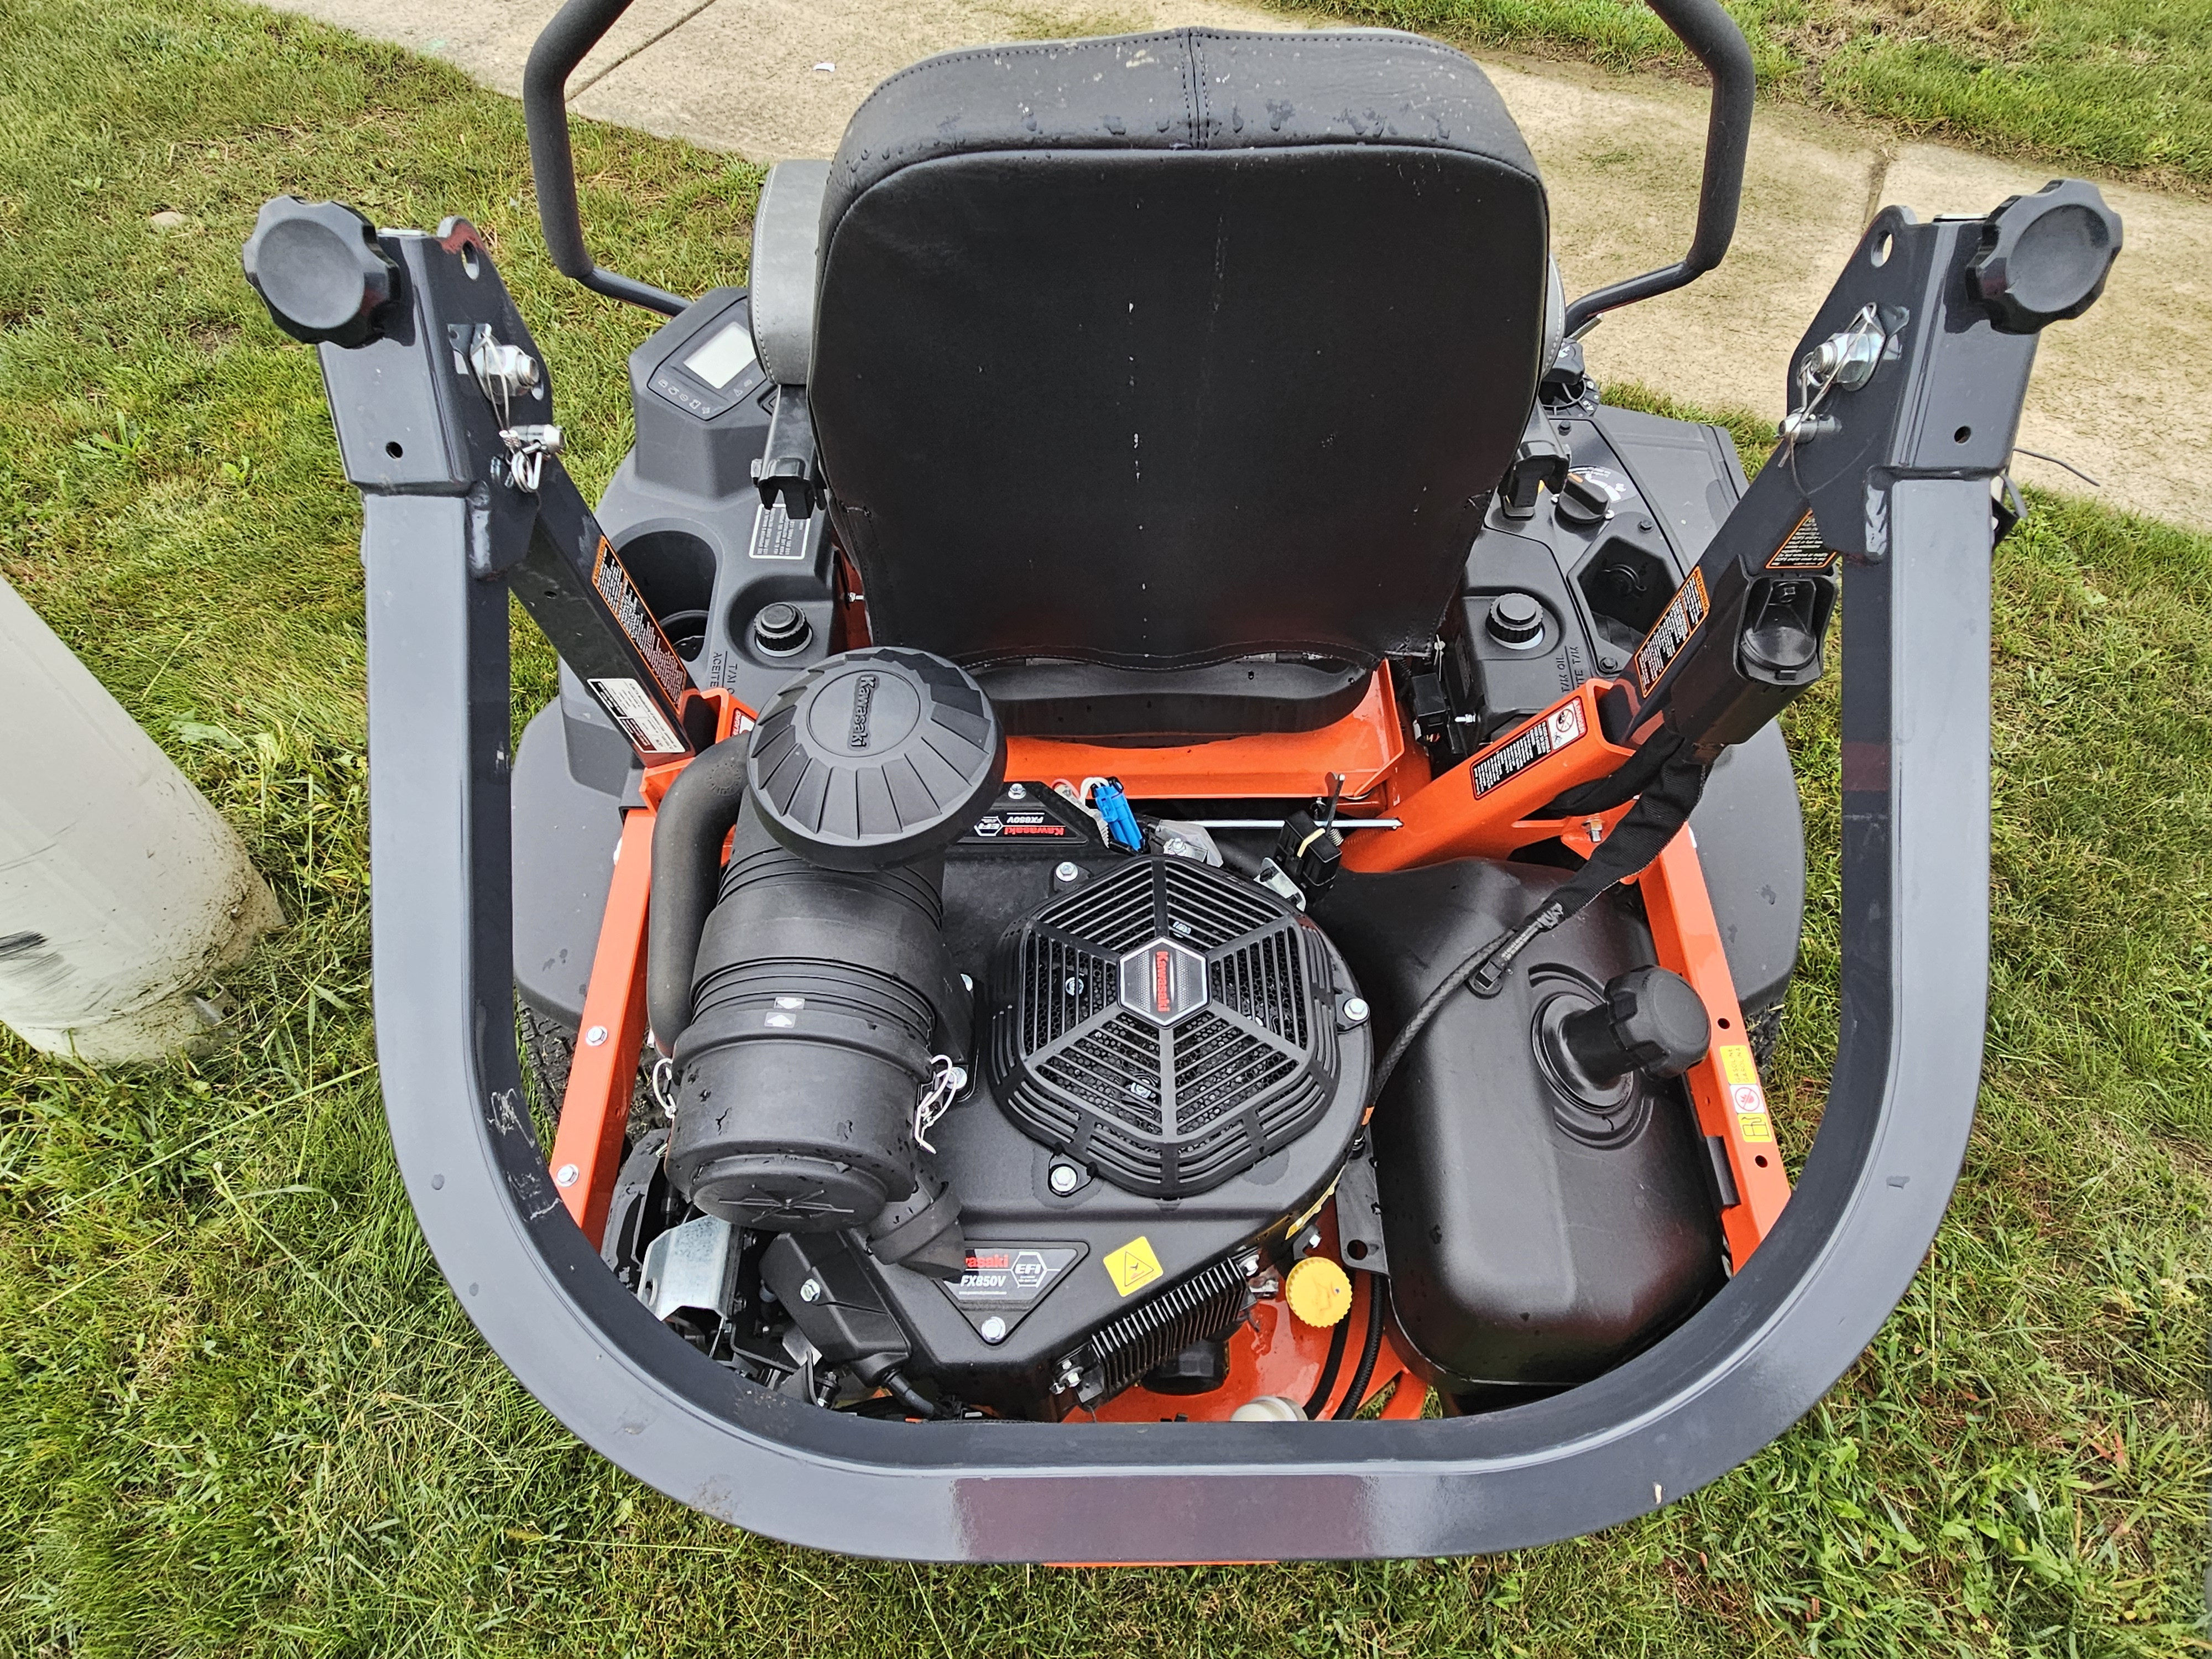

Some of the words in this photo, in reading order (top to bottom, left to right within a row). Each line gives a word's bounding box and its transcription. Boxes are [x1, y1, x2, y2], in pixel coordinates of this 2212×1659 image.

[710, 651, 722, 687] ACEITE
[1556, 655, 1565, 670] OIL
[733, 711, 741, 735] ELIGRO
[851, 677, 876, 747] Kawasaki
[1574, 705, 1585, 734] DANGER
[1004, 827, 1065, 836] Kawasaki
[1156, 951, 1170, 1011] Kawasaki
[1728, 1049, 1740, 1082] GASOLINE
[1736, 1047, 1749, 1082] GASOLINA
[960, 1275, 1006, 1287] FX850V
[1015, 1264, 1041, 1274] EFI
